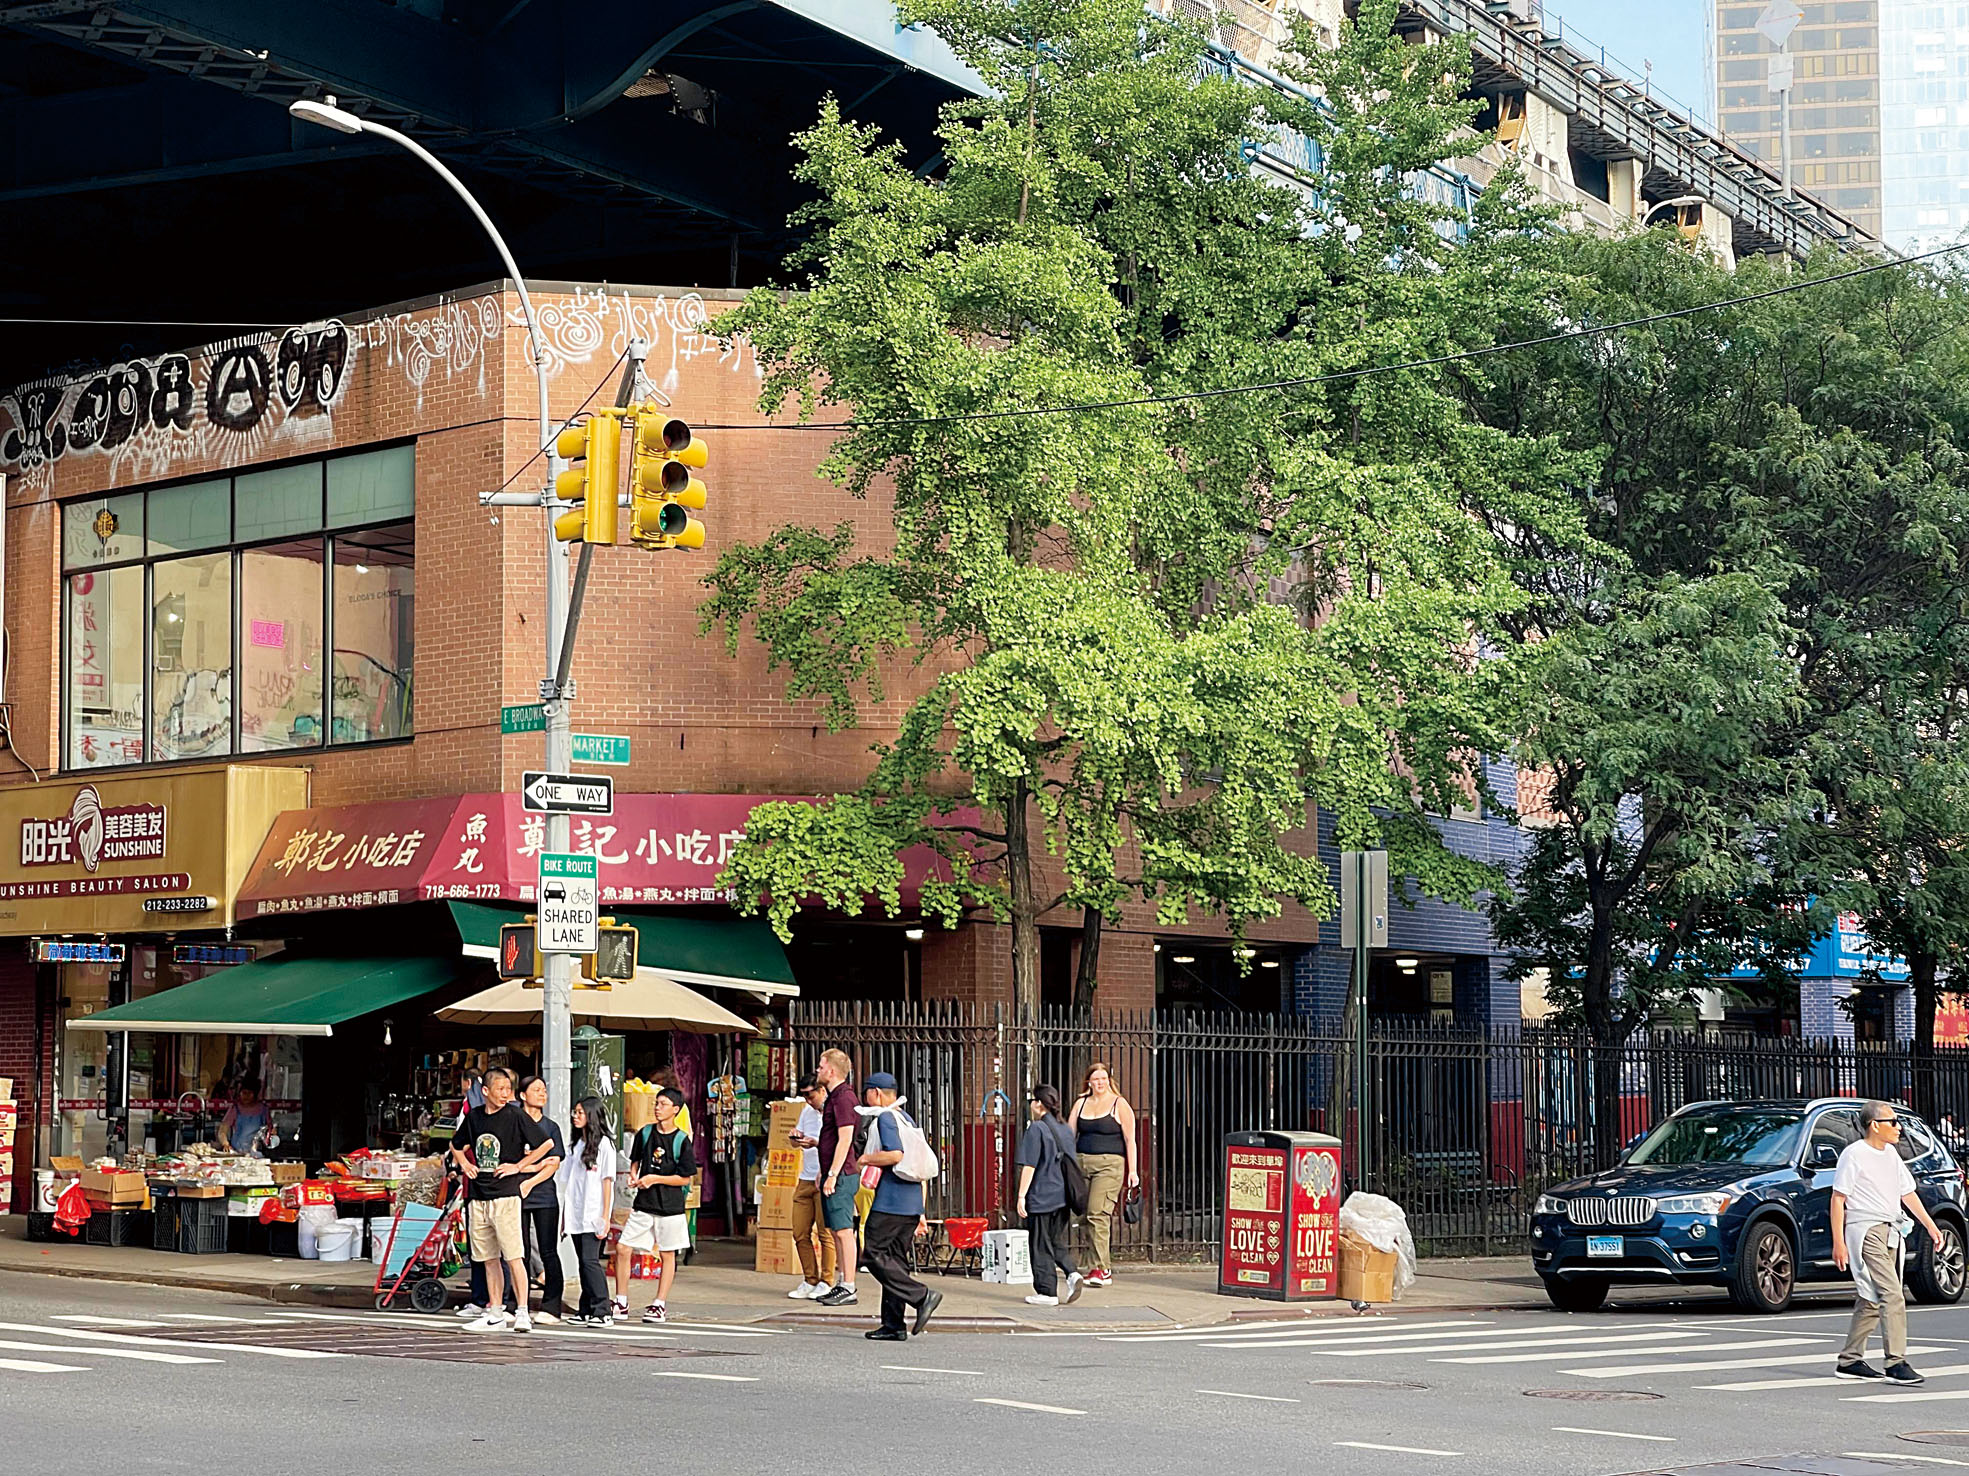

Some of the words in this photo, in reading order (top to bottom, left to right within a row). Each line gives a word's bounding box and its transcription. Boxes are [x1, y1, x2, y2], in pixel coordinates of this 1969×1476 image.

[504, 711, 508, 724] E
[511, 705, 545, 723] BROADWA
[573, 737, 616, 754] MARKET
[619, 739, 626, 748] ST
[535, 785, 562, 800] ONE
[576, 787, 603, 802] WAY
[104, 811, 163, 839] 美容美发
[22, 820, 71, 864] 阳光
[104, 838, 162, 859] SUNSHINE
[452, 812, 488, 873] 魚丸
[274, 827, 426, 877] 鄭記小吃店
[544, 859, 563, 872] BIKE
[566, 859, 593, 874] ROUTE
[0, 882, 59, 897] UNSHINE
[70, 879, 123, 892] BEAUTY
[134, 876, 180, 890] SALON
[425, 884, 501, 898] 718-666-1773
[146, 898, 206, 912] 212-233-2282
[544, 909, 593, 924] SHARED
[552, 928, 584, 943] LANE
[1231, 1217, 1252, 1229] SHOW
[1298, 1213, 1321, 1229] SHOW
[1230, 1229, 1265, 1251] LOVE
[1297, 1229, 1334, 1257] LOVE
[1241, 1252, 1265, 1264] CLEAN
[1308, 1259, 1333, 1273] CLEAN
